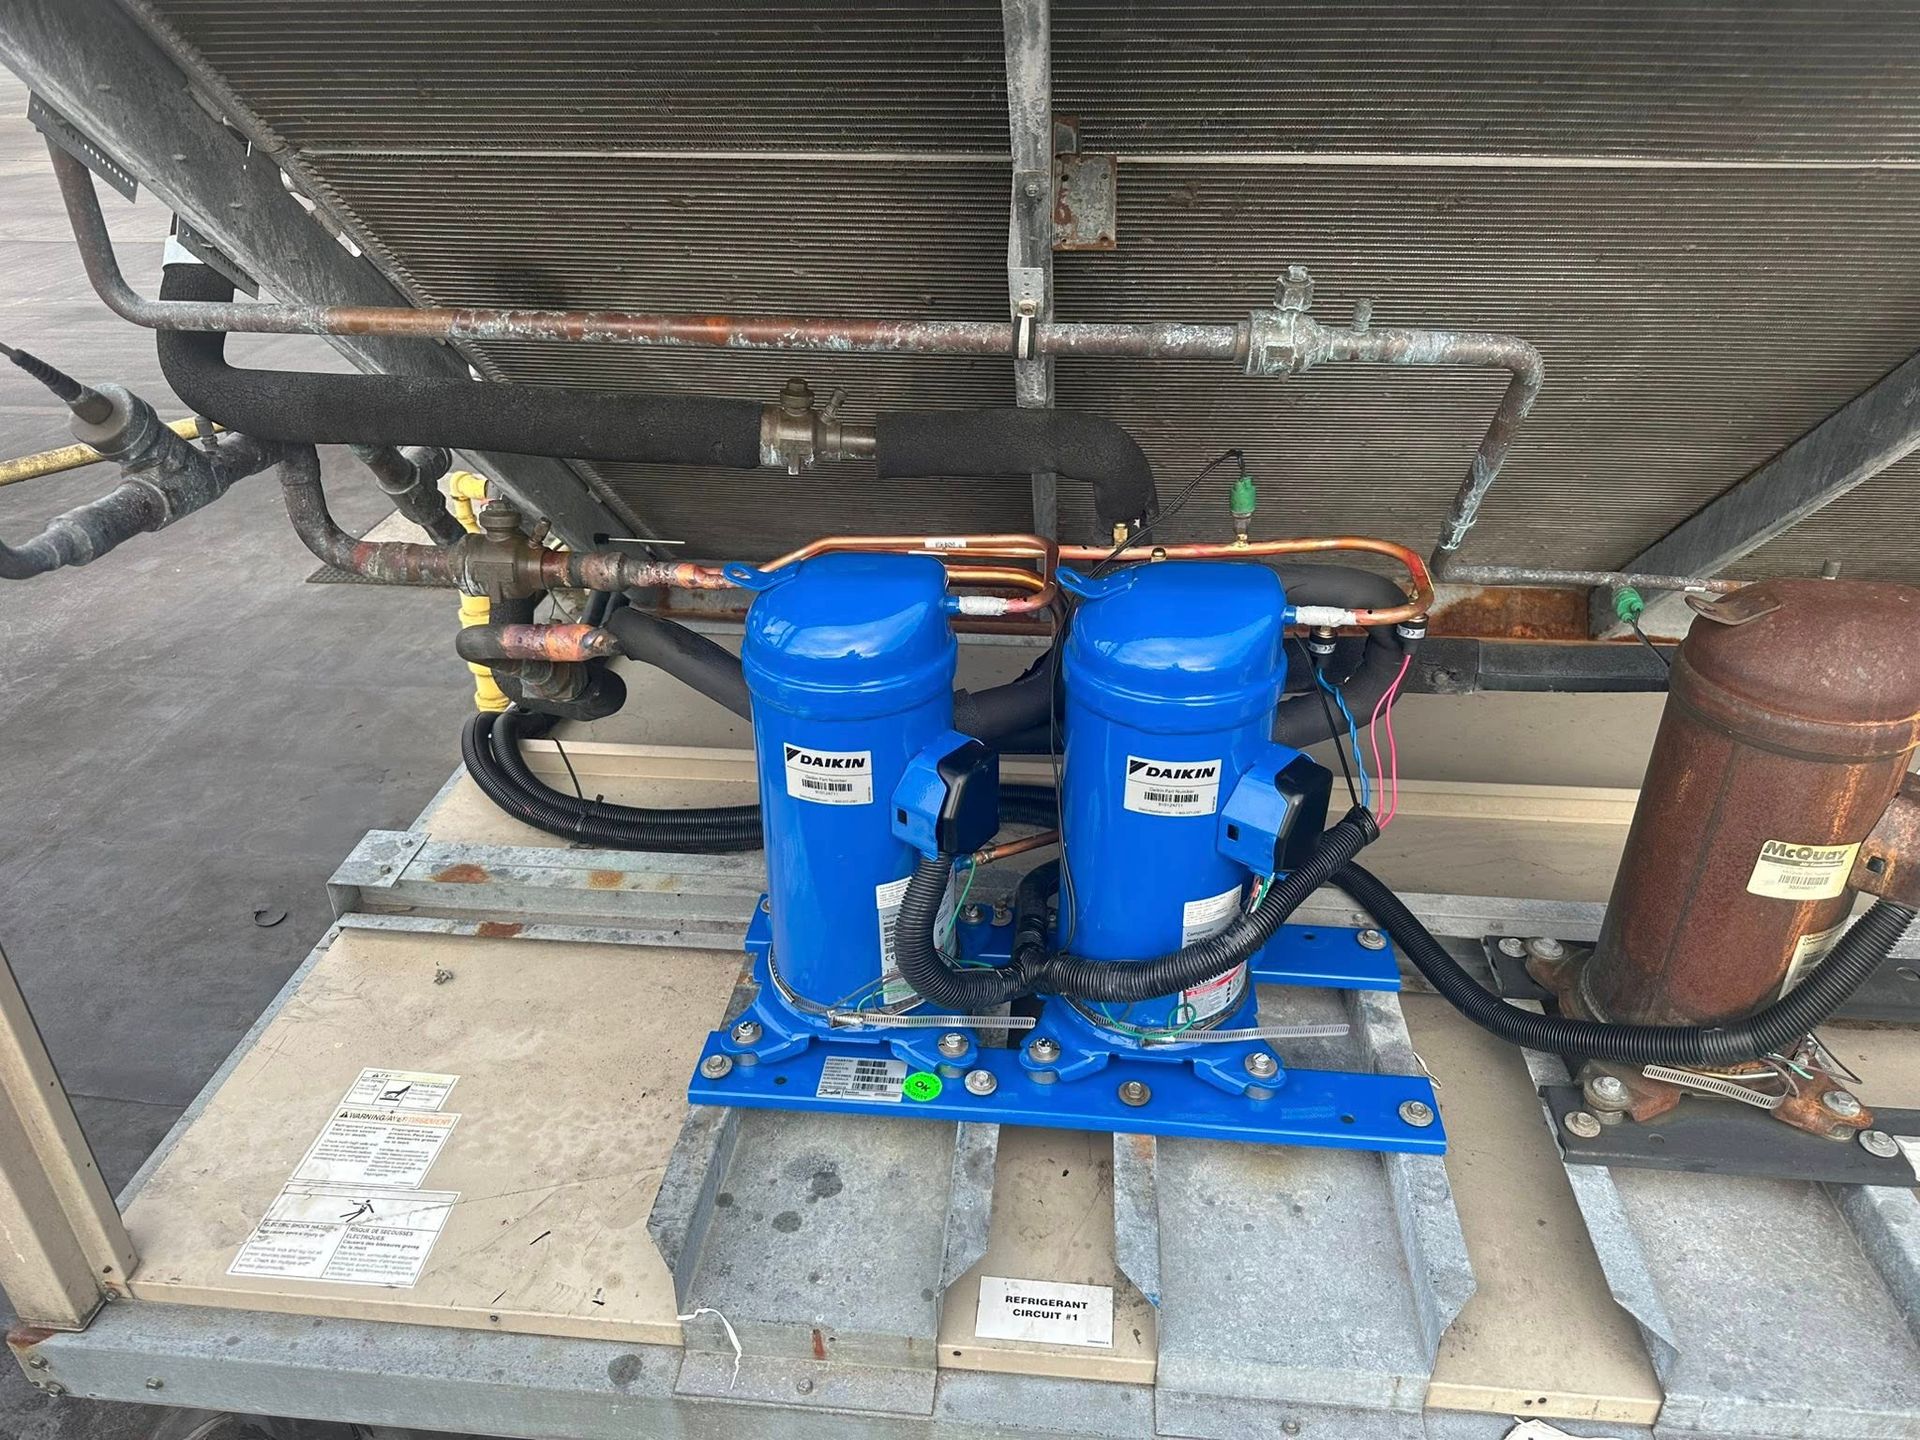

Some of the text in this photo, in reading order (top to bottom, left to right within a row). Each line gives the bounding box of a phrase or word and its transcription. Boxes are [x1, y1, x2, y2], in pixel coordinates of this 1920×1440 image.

[800, 755, 865, 768] DAIKIN
[1146, 767, 1215, 779] DAIKIN
[1763, 842, 1848, 860] McQuay
[915, 1080, 931, 1092] OK
[1005, 1296, 1088, 1309] REFRIGERANT
[1013, 1308, 1078, 1321] CIRCUIT #1
